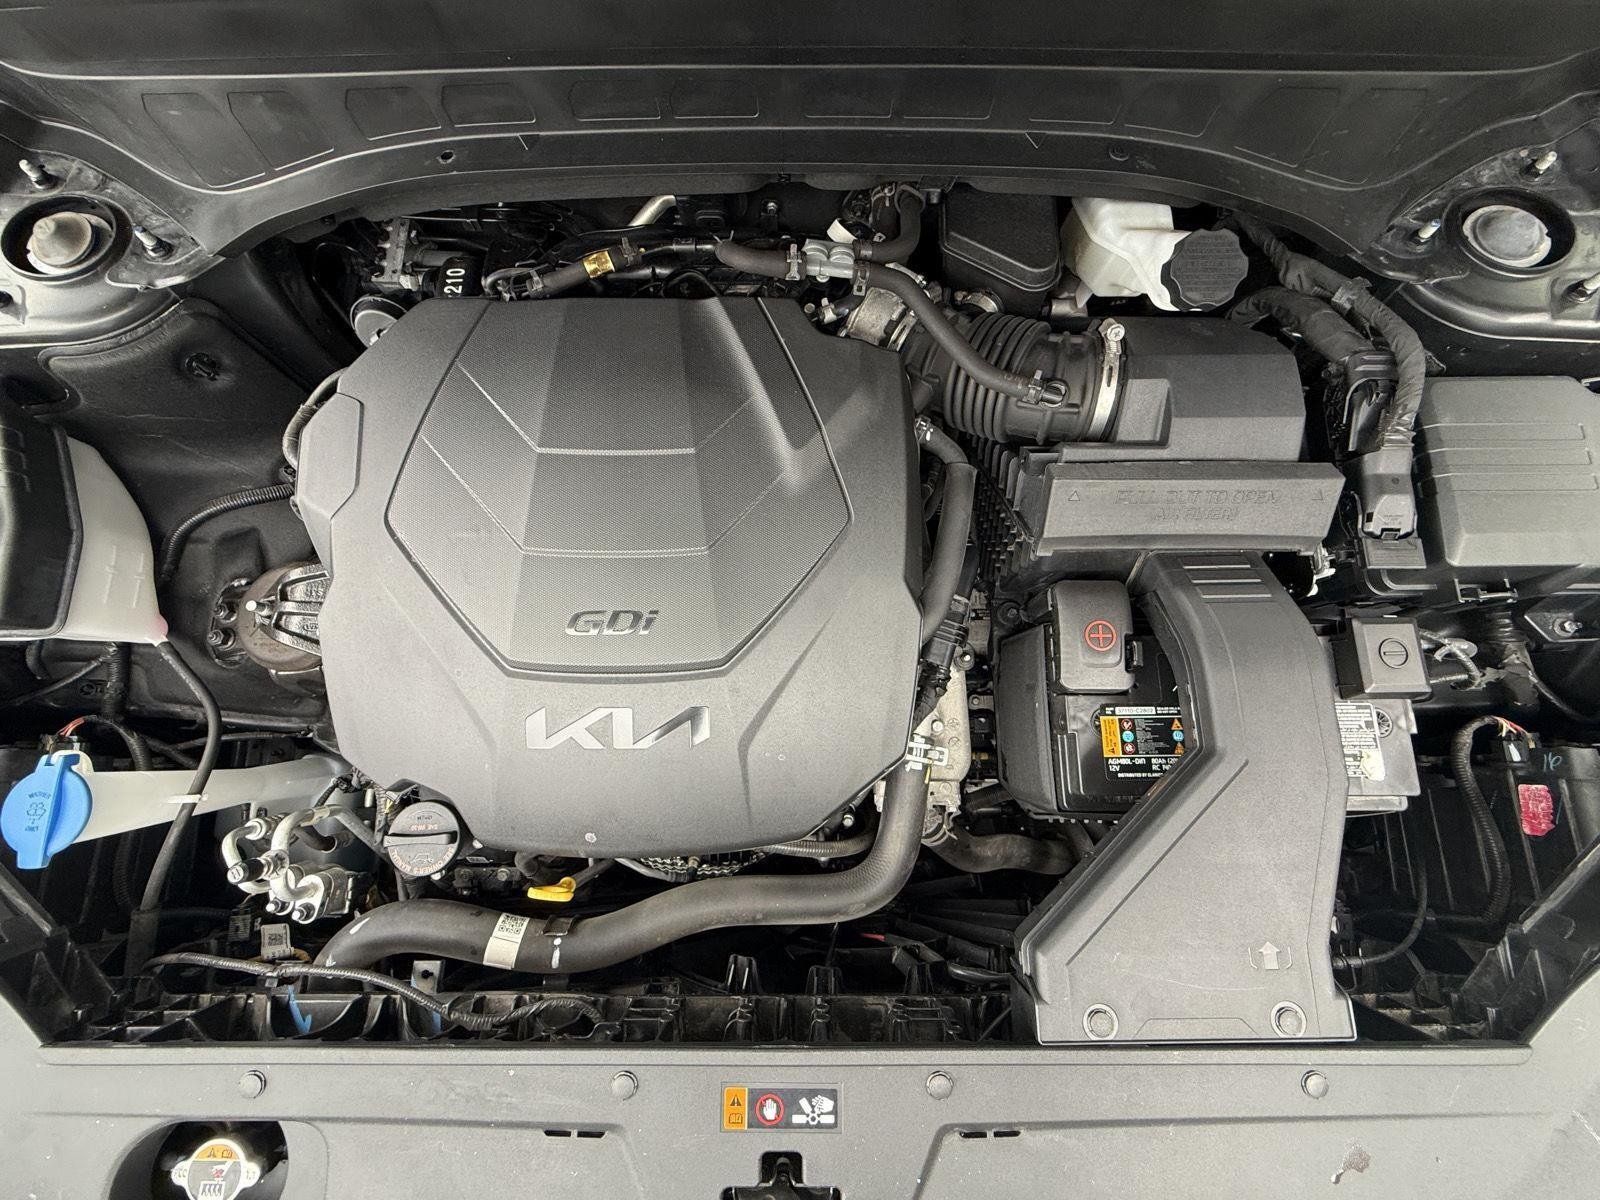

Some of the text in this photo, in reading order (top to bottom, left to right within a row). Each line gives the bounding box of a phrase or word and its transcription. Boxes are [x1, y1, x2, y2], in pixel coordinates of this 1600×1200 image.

[443, 267, 466, 297] 210
[1232, 489, 1282, 505] OPEN
[564, 609, 660, 636] GDi
[525, 705, 710, 750] KIA
